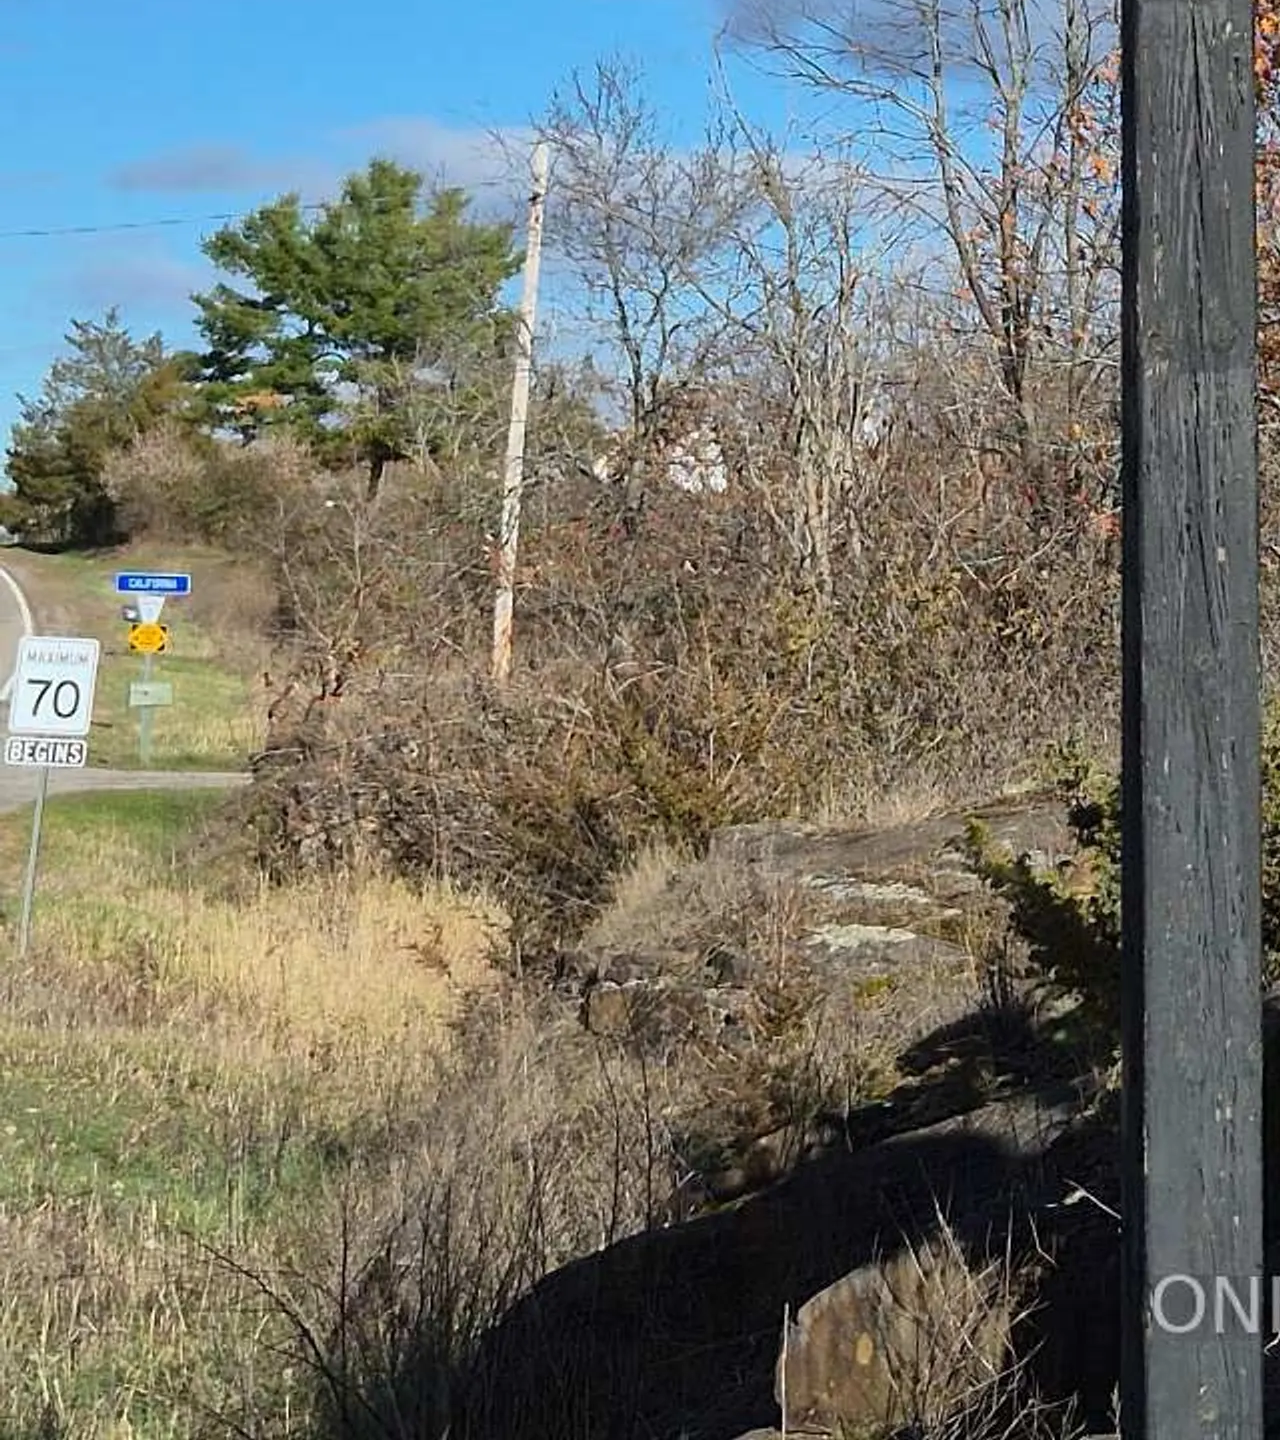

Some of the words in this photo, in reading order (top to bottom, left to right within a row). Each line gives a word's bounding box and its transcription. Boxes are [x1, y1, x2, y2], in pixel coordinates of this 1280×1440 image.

[27, 647, 89, 665] MAXIMUM
[27, 678, 80, 719] 70
[9, 740, 83, 764] BEGINS
